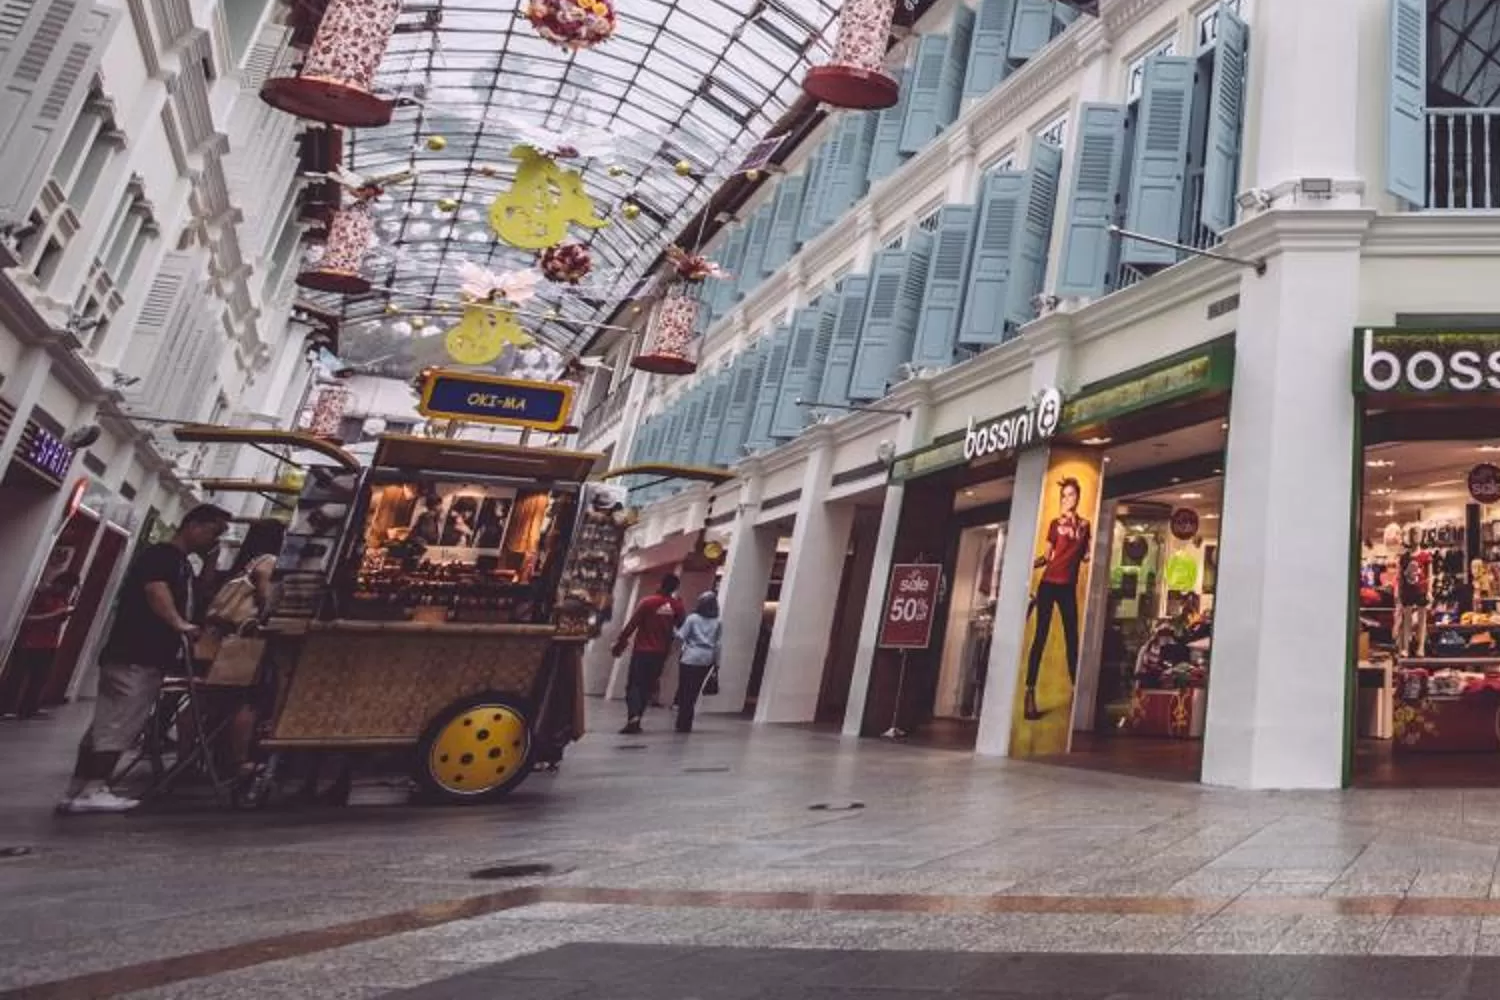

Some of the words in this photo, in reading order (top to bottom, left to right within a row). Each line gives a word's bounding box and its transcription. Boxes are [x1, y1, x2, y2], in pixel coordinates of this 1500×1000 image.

[466, 392, 527, 411] OKI-MA
[964, 415, 1035, 460] bossini
[899, 575, 930, 593] sale
